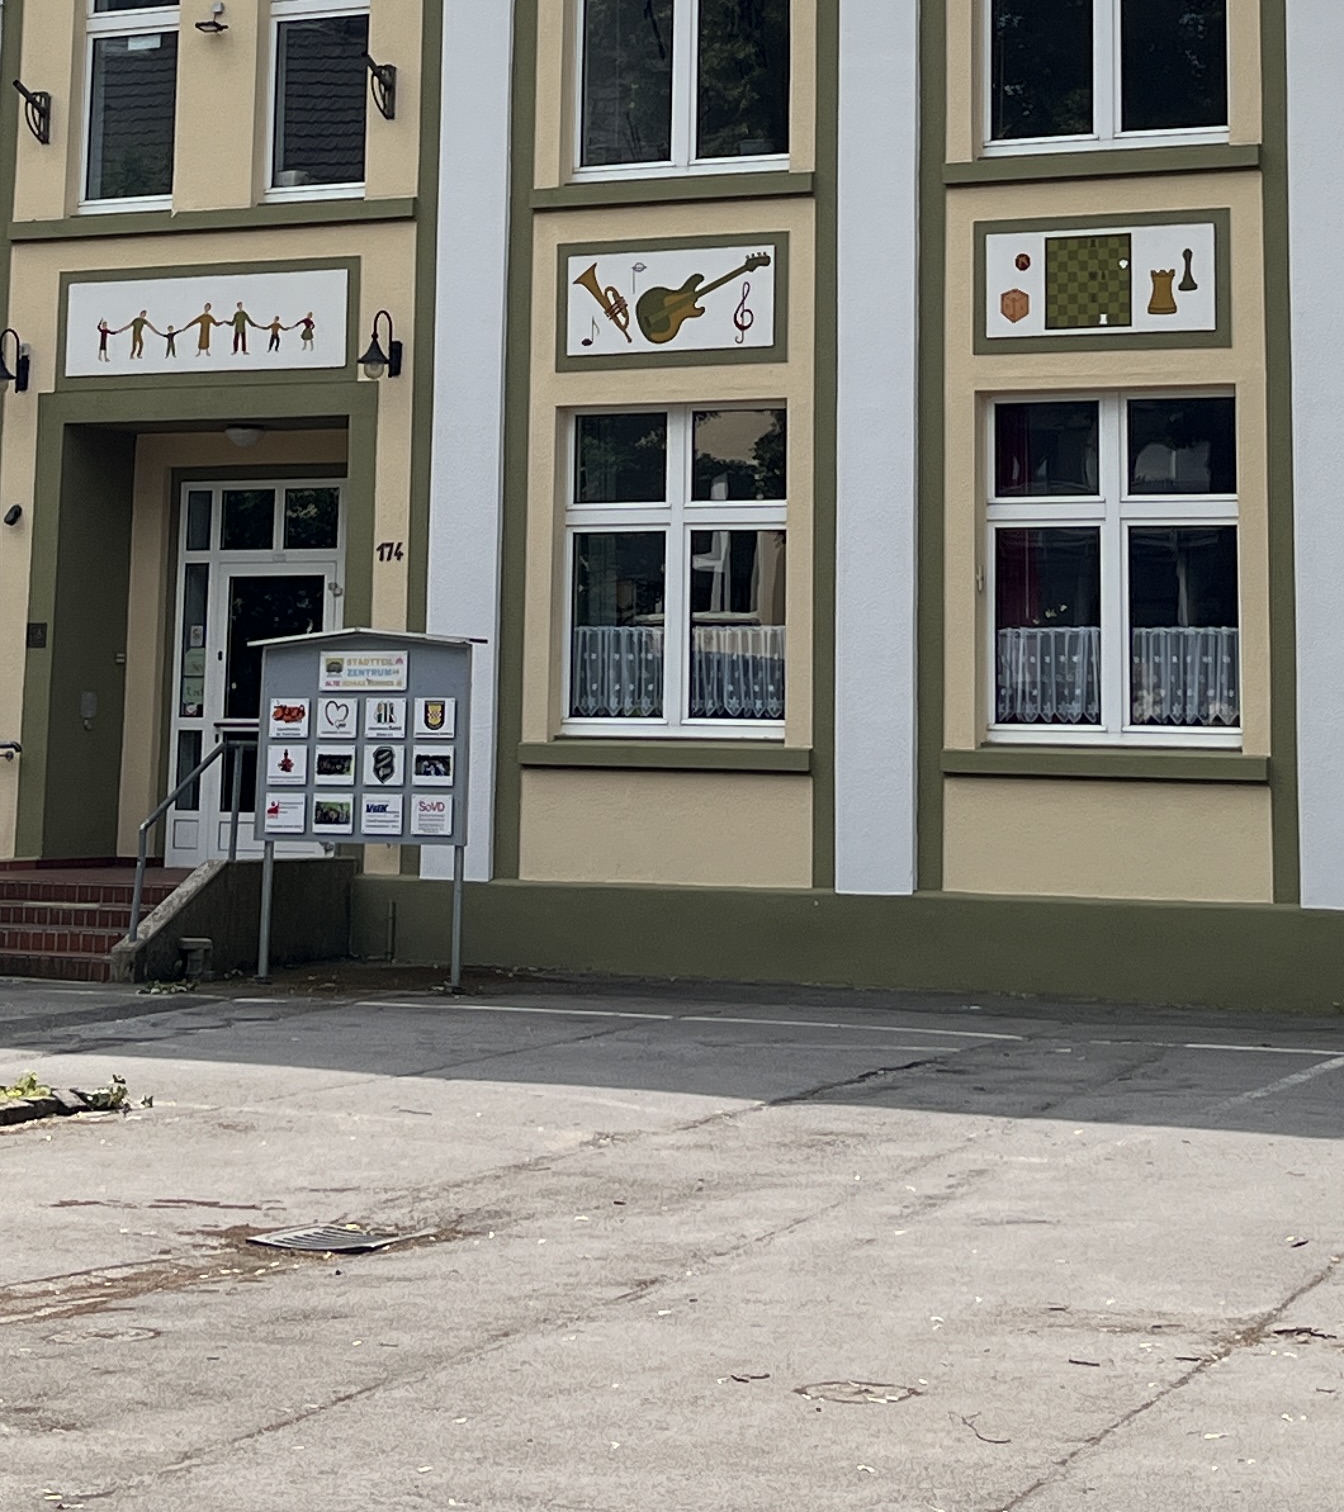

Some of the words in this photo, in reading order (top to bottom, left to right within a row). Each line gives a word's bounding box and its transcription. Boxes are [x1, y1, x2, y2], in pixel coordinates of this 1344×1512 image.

[376, 541, 404, 562] 174
[346, 668, 393, 677] ZENTRUM
[418, 800, 446, 812] SoVD
